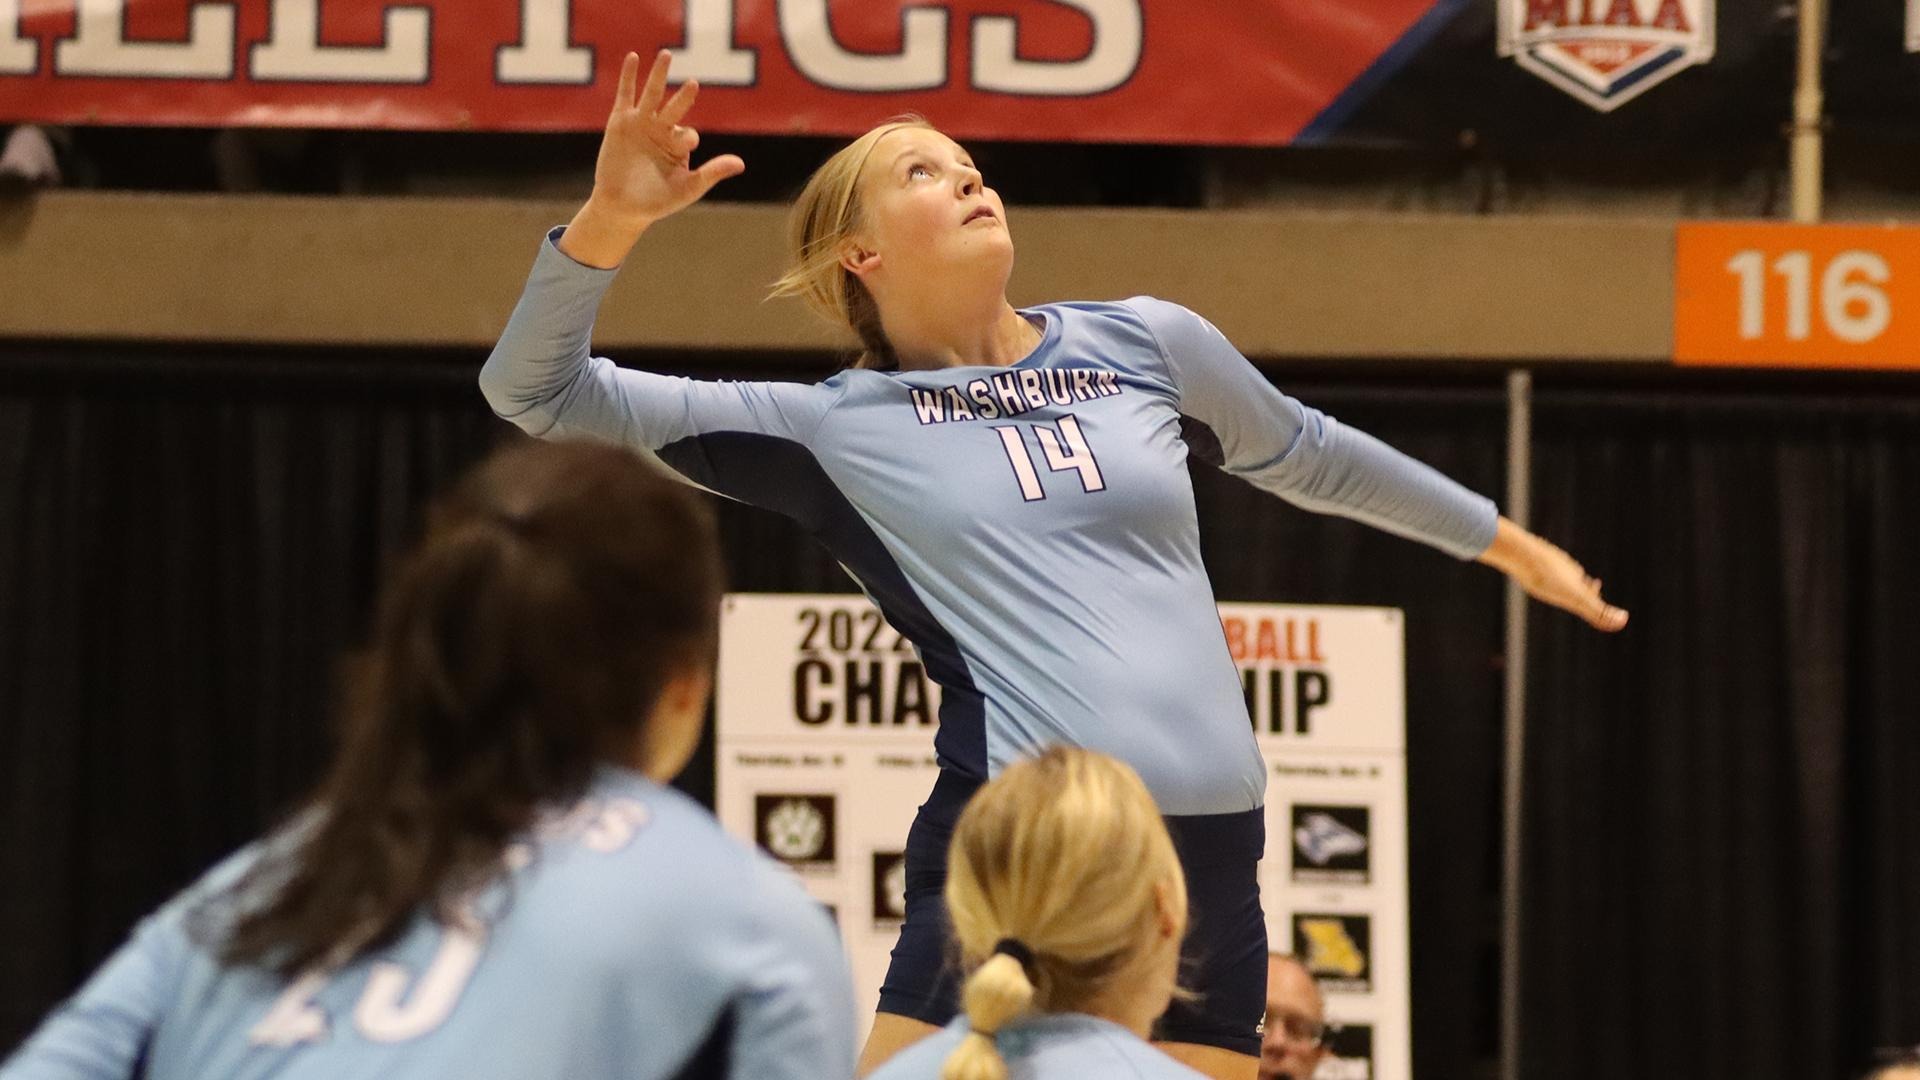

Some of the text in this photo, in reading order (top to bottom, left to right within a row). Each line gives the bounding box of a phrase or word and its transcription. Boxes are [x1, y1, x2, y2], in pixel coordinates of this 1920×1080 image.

[1726, 249, 1891, 344] 116
[909, 367, 1122, 425] WASHBURN
[990, 412, 1107, 502] 14
